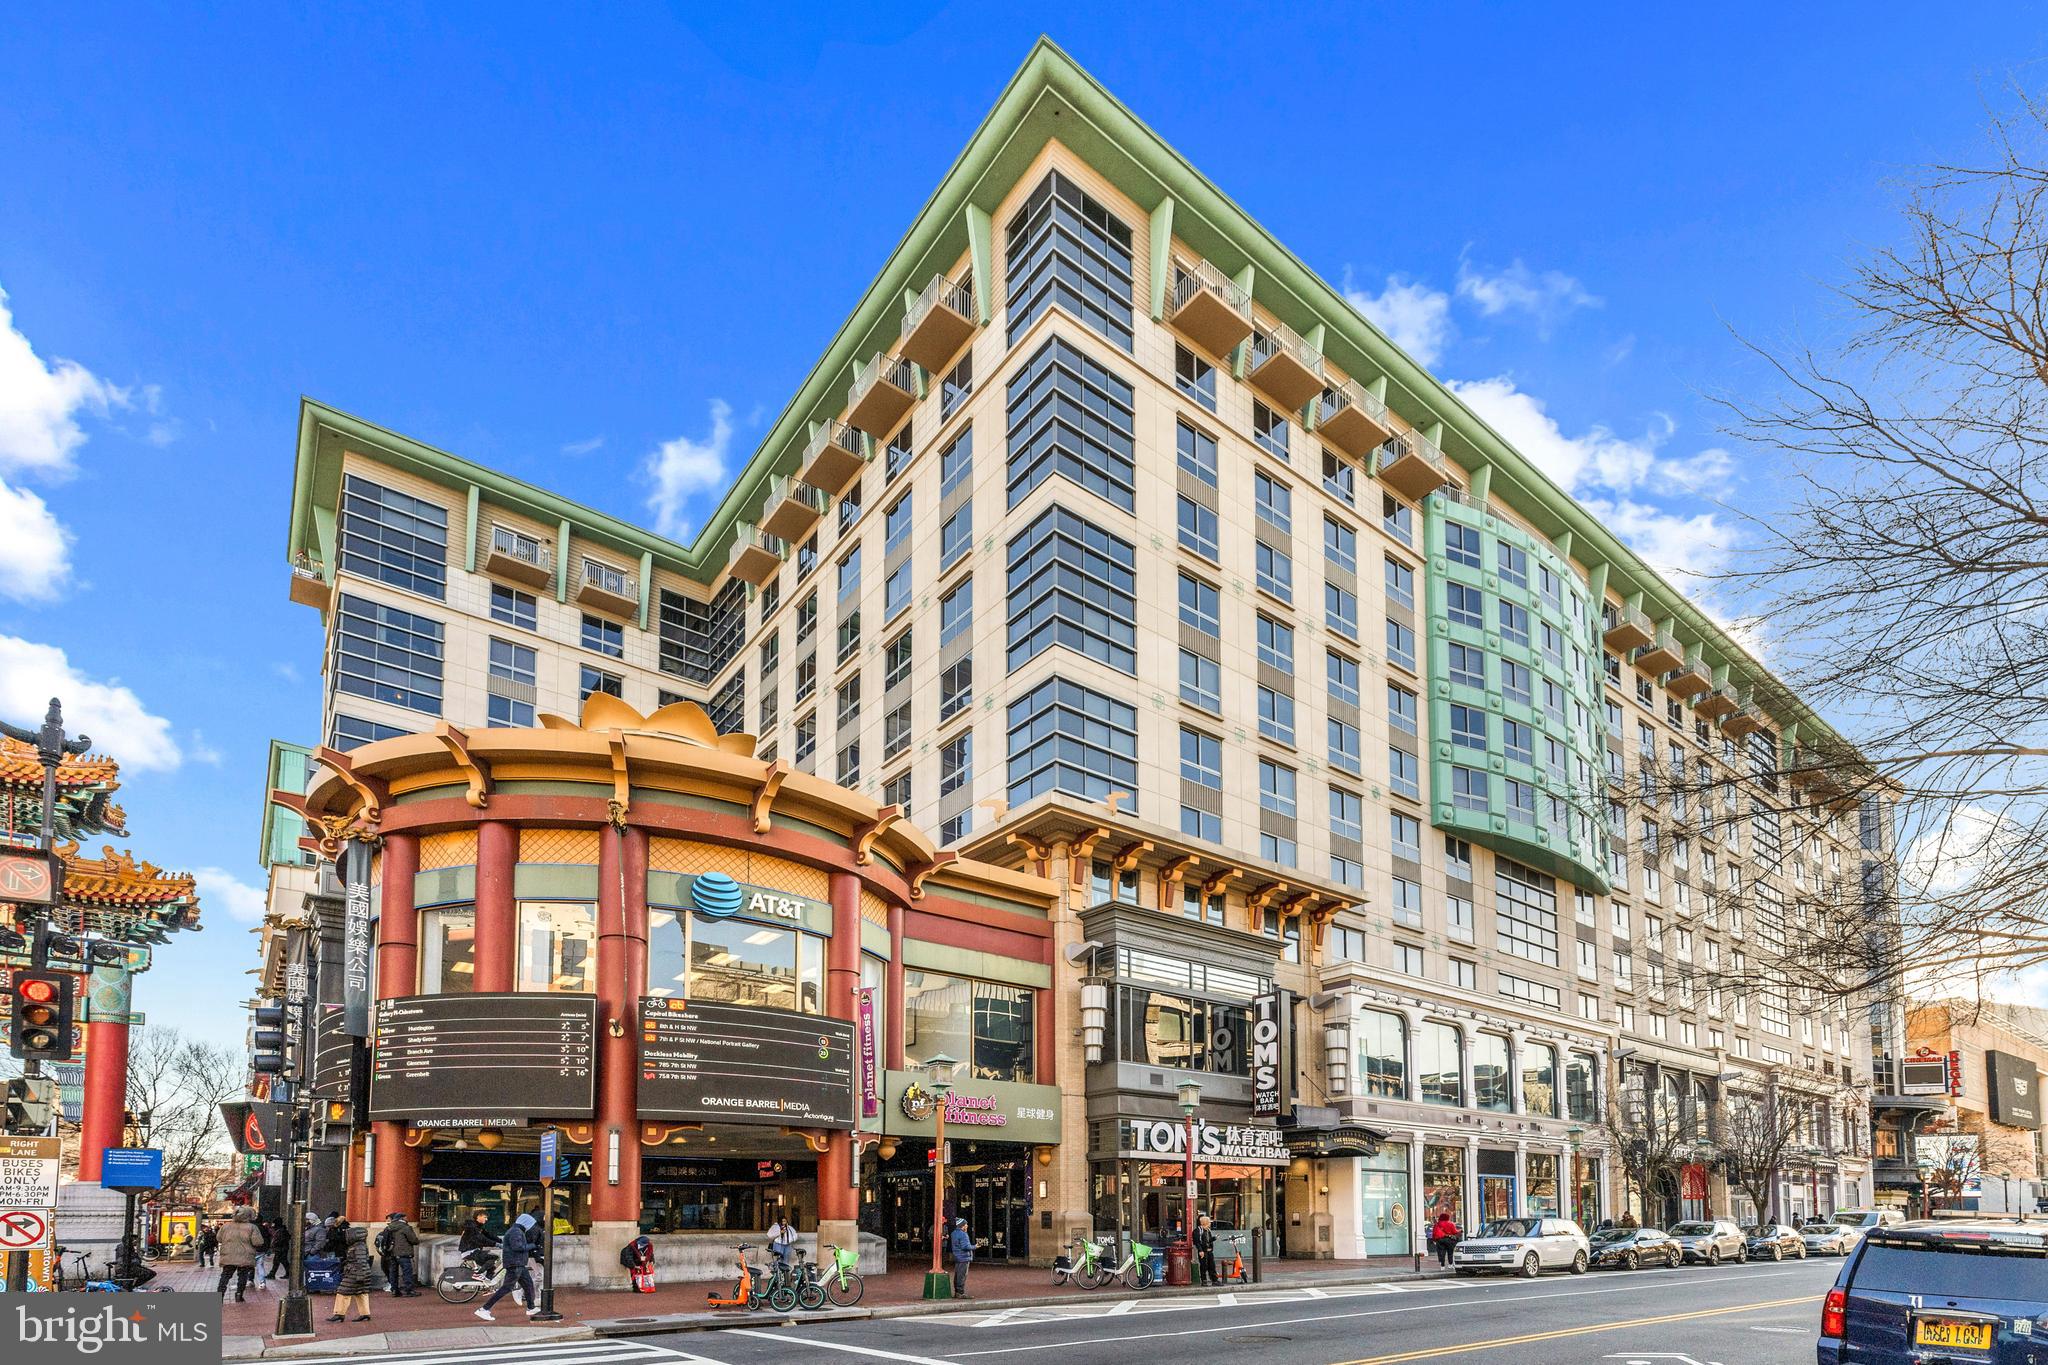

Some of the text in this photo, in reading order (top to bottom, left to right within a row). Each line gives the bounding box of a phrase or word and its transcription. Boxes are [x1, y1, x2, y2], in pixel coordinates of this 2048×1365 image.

[748, 893, 805, 920] AT&T
[348, 882, 369, 992] 美國娛樂公司
[742, 1042, 760, 1050] Gallery
[1254, 996, 1278, 1090] TOMS
[863, 1013, 876, 1101] planet fitness
[1949, 1050, 1962, 1098] REGAL
[701, 1097, 810, 1111] ORANGE BARREL MEDIA
[944, 1106, 1007, 1126] fitness
[1016, 1106, 1054, 1120] 星球健身
[416, 1118, 517, 1128] ORANGE BARREL MEDIA
[1130, 1118, 1221, 1156] TOM'S
[1226, 1126, 1284, 1147] 体育酒吧
[10, 1140, 39, 1148] RIGHT
[1221, 1145, 1290, 1159] WATCH BAR
[2, 1159, 44, 1168] BUSES
[4, 1168, 41, 1176] BIKES
[4, 1176, 39, 1184] ONLY
[1097, 1236, 1115, 1244] TOM'S
